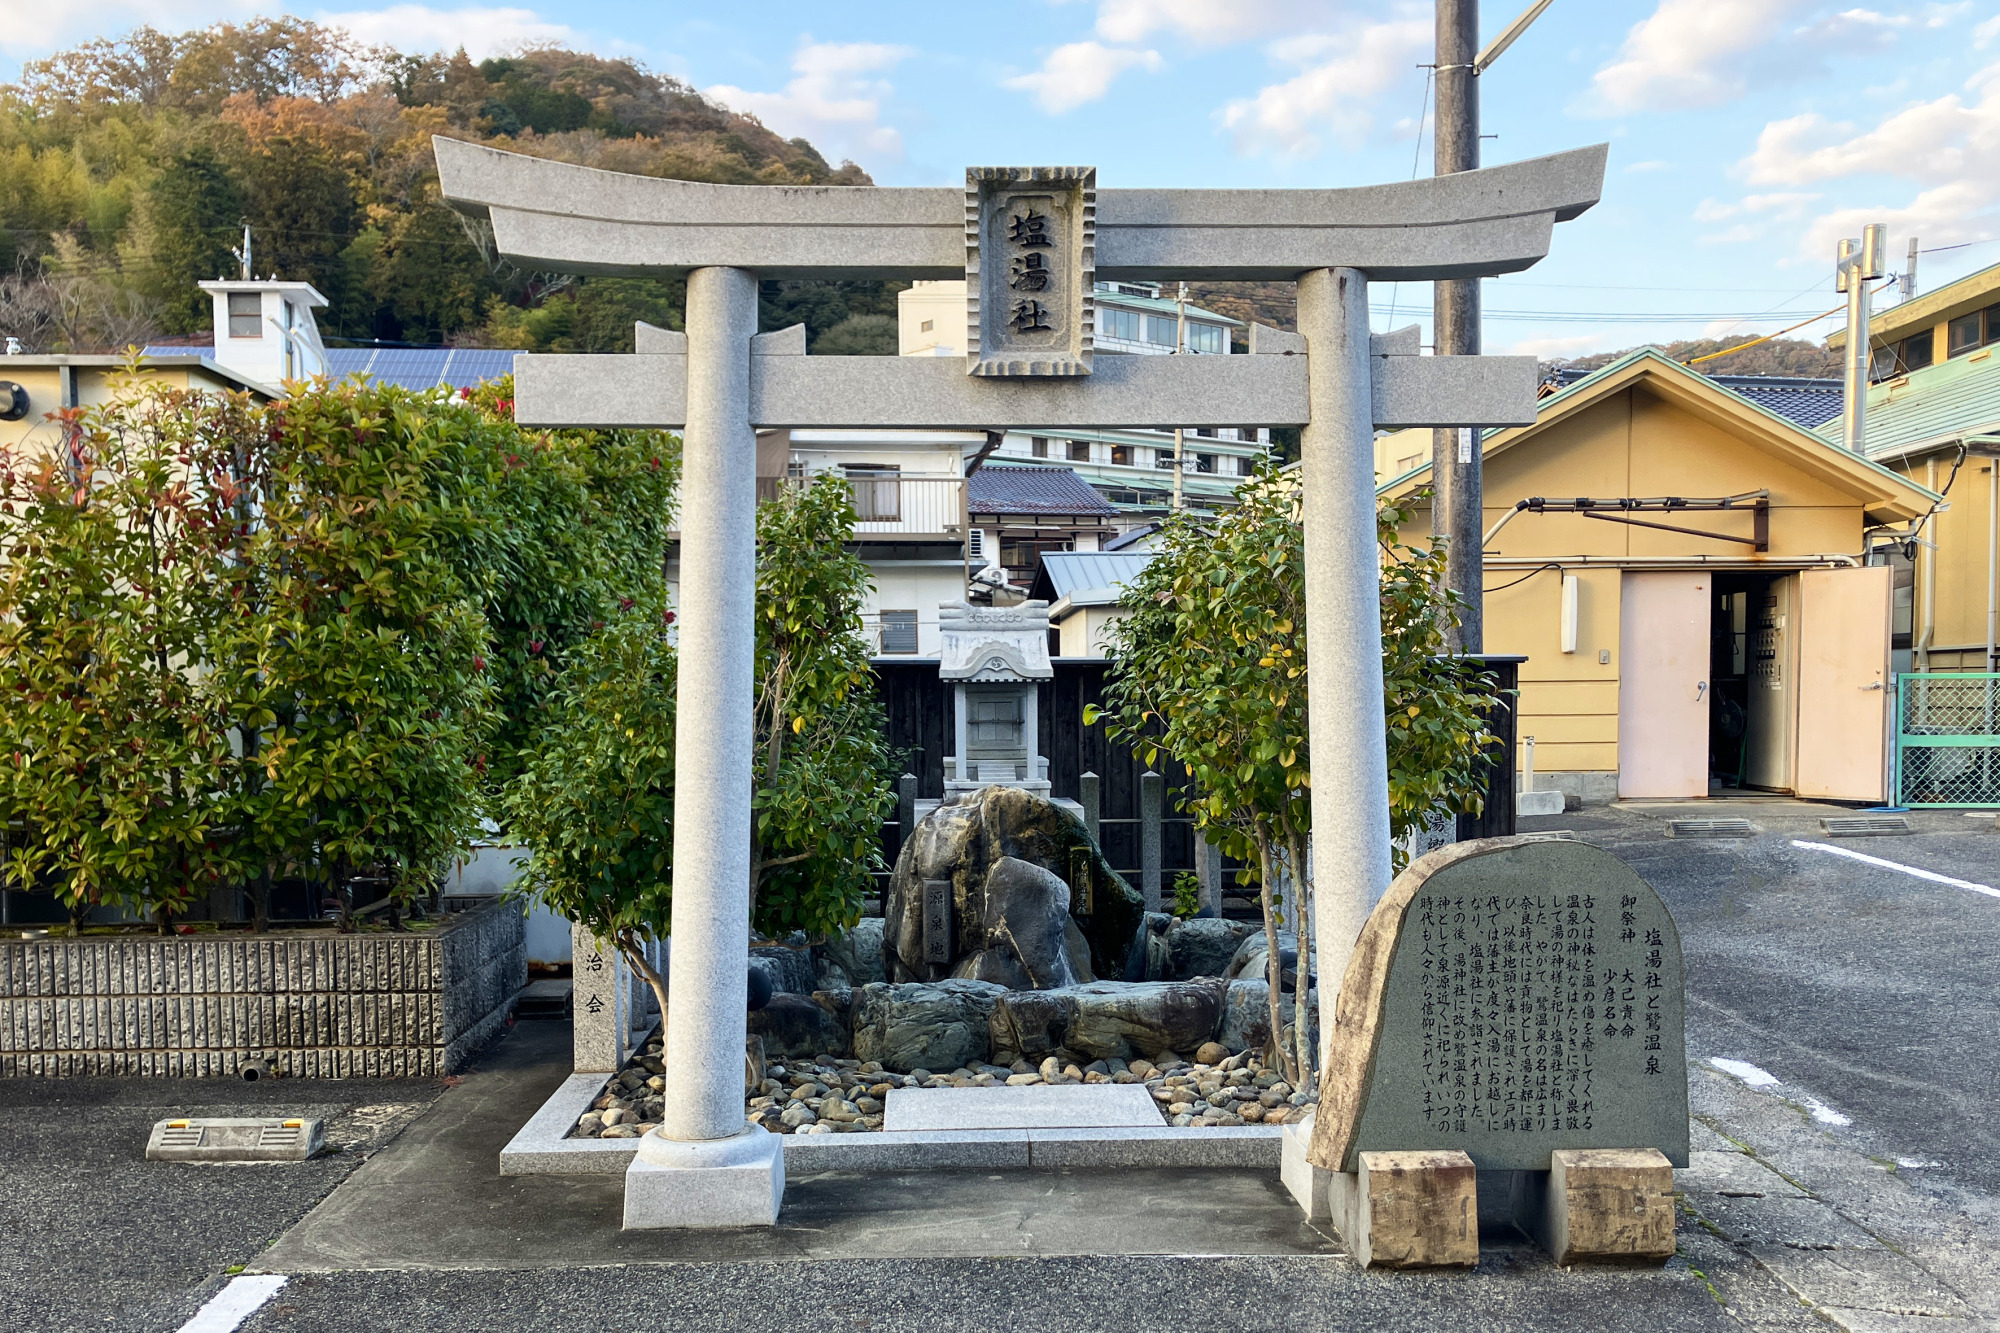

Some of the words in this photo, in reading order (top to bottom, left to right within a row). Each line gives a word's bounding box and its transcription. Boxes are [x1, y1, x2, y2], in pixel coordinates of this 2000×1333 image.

[1007, 208, 1053, 334] 塩湯社
[929, 890, 945, 956] 源泉地
[1619, 894, 1637, 944] 御祭神
[585, 952, 605, 1014] 治会
[1519, 895, 1534, 1132] 奈良時代には貢物として湯を都に運
[1550, 894, 1565, 1132] して湯の神様を祀り塩湯社と称しま
[1566, 894, 1581, 1131] 温泉の神秘なはたらきに深く畏敬
[1603, 968, 1619, 1039] 少彦名命
[1620, 968, 1637, 1039] 大己貴命
[1644, 927, 1664, 1076] 塩湯社と鷺温泉
